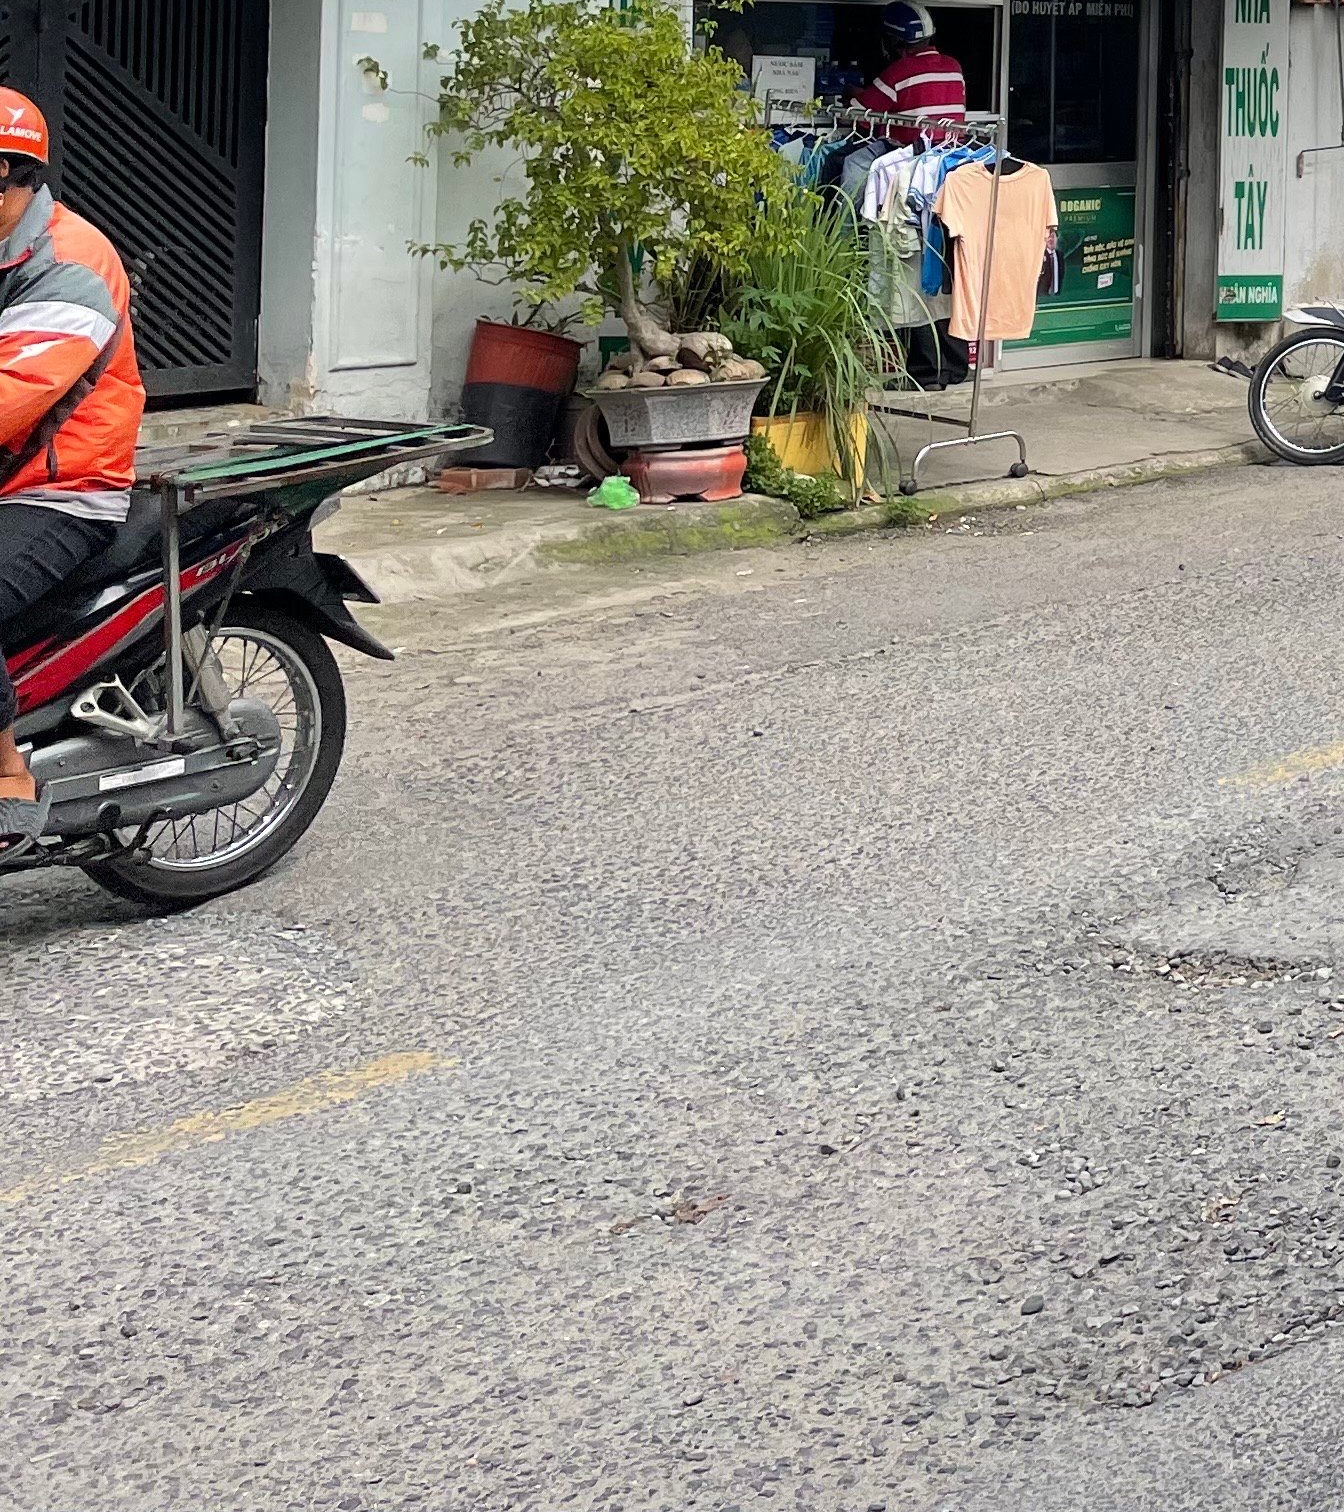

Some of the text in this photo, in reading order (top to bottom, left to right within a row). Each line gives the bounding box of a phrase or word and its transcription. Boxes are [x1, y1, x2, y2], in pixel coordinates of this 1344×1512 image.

[1225, 43, 1280, 138] THUỐC
[1235, 164, 1268, 250] TÂY
[1247, 281, 1278, 304] NGHĨA
